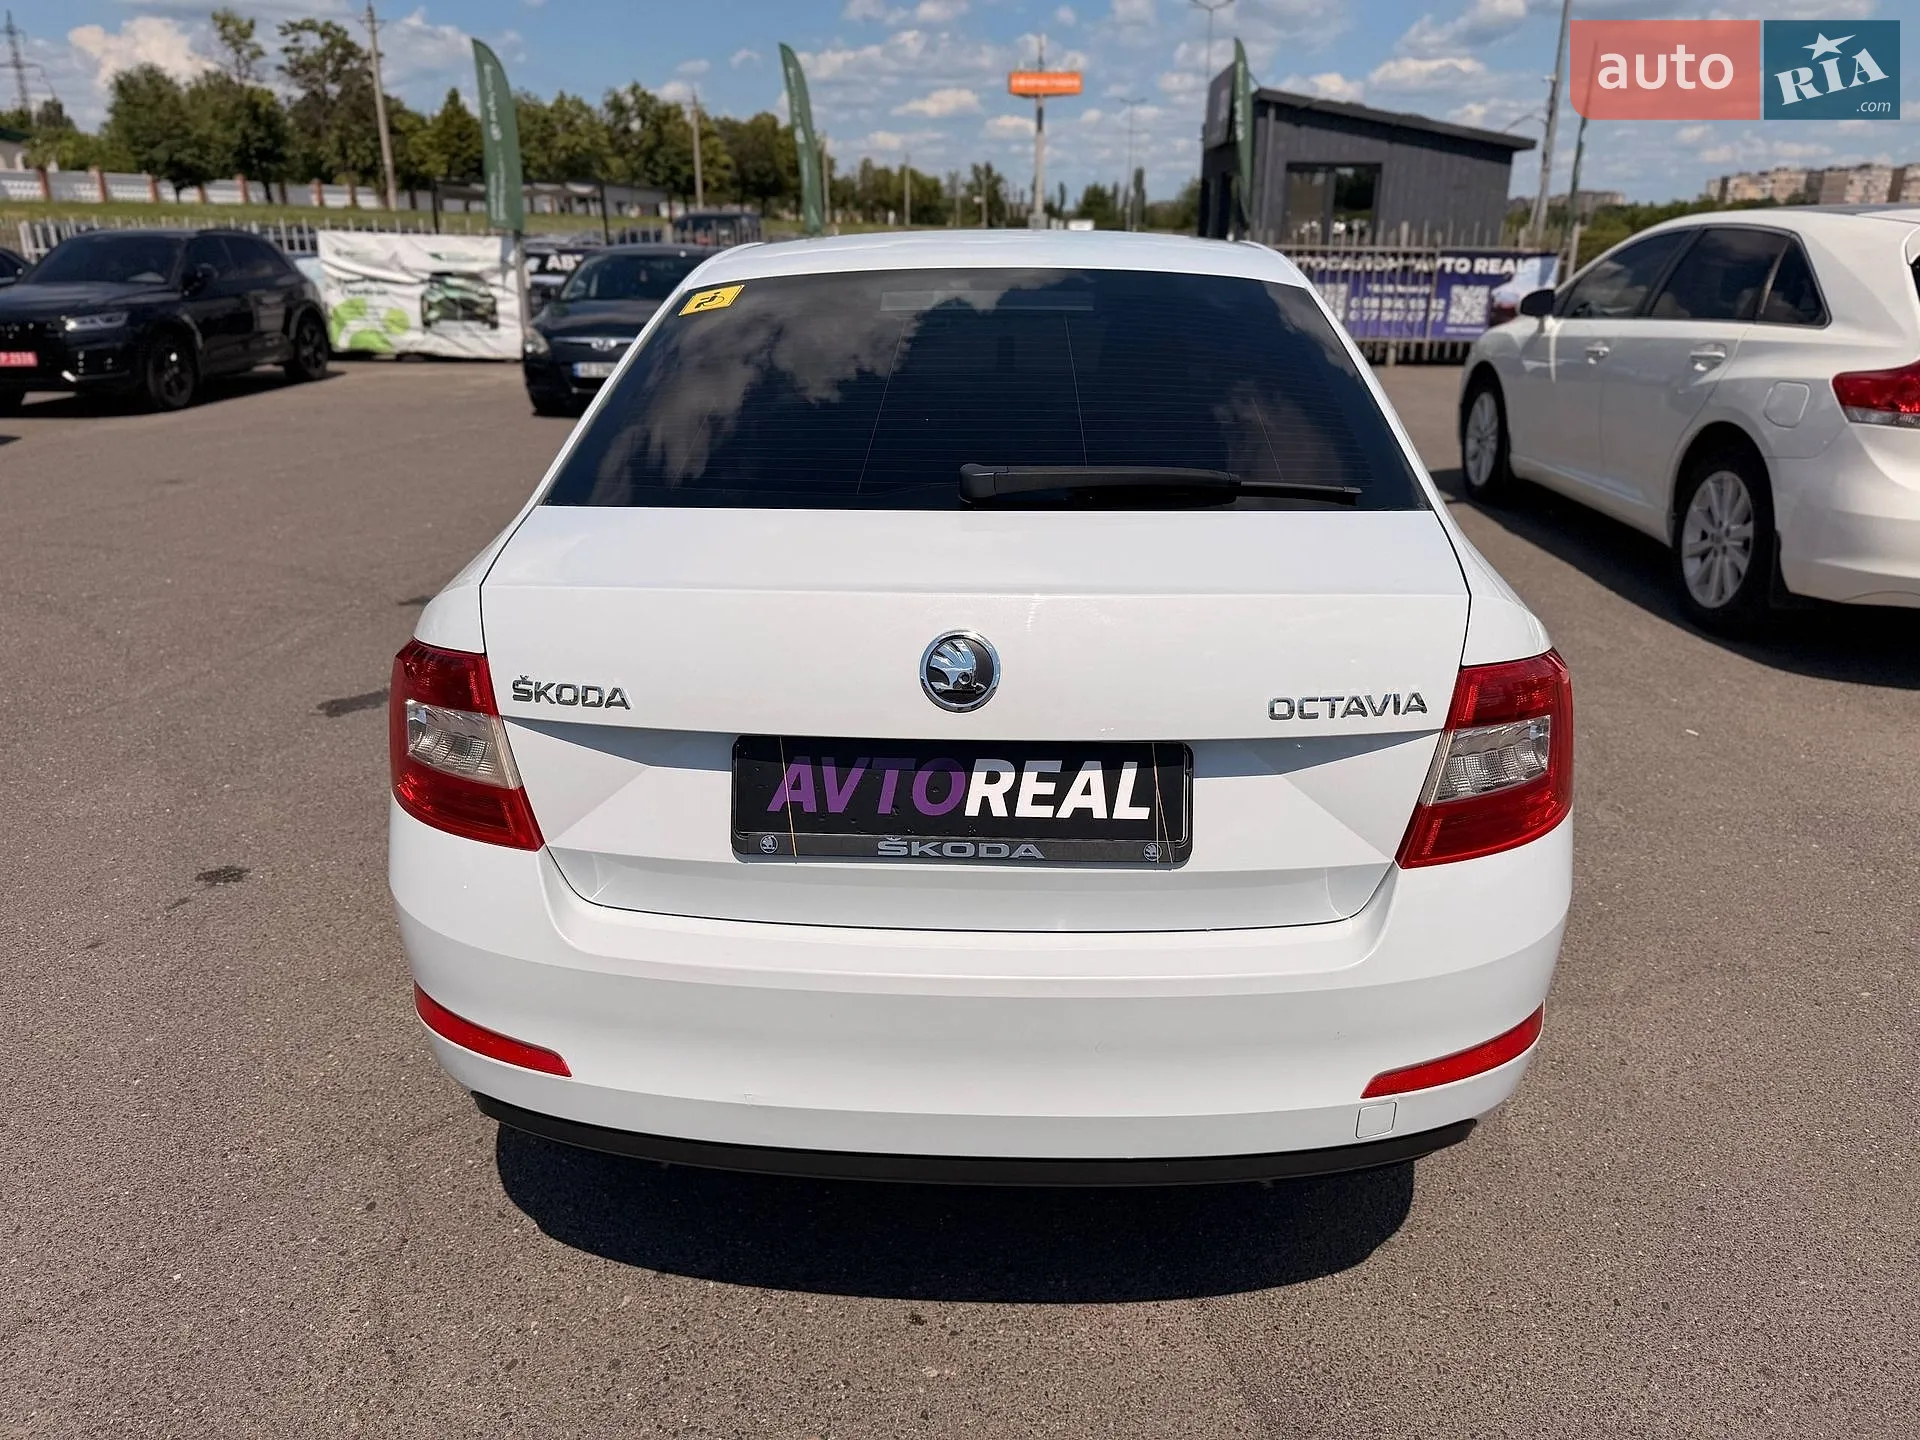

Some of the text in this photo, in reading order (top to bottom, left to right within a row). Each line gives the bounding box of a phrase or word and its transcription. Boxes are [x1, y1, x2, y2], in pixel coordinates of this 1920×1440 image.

[512, 674, 631, 710] ŠKODA
[1268, 692, 1428, 720] OCTAVIA
[766, 755, 1152, 820] AVTOREAL
[877, 836, 1046, 860] ŠKODA
